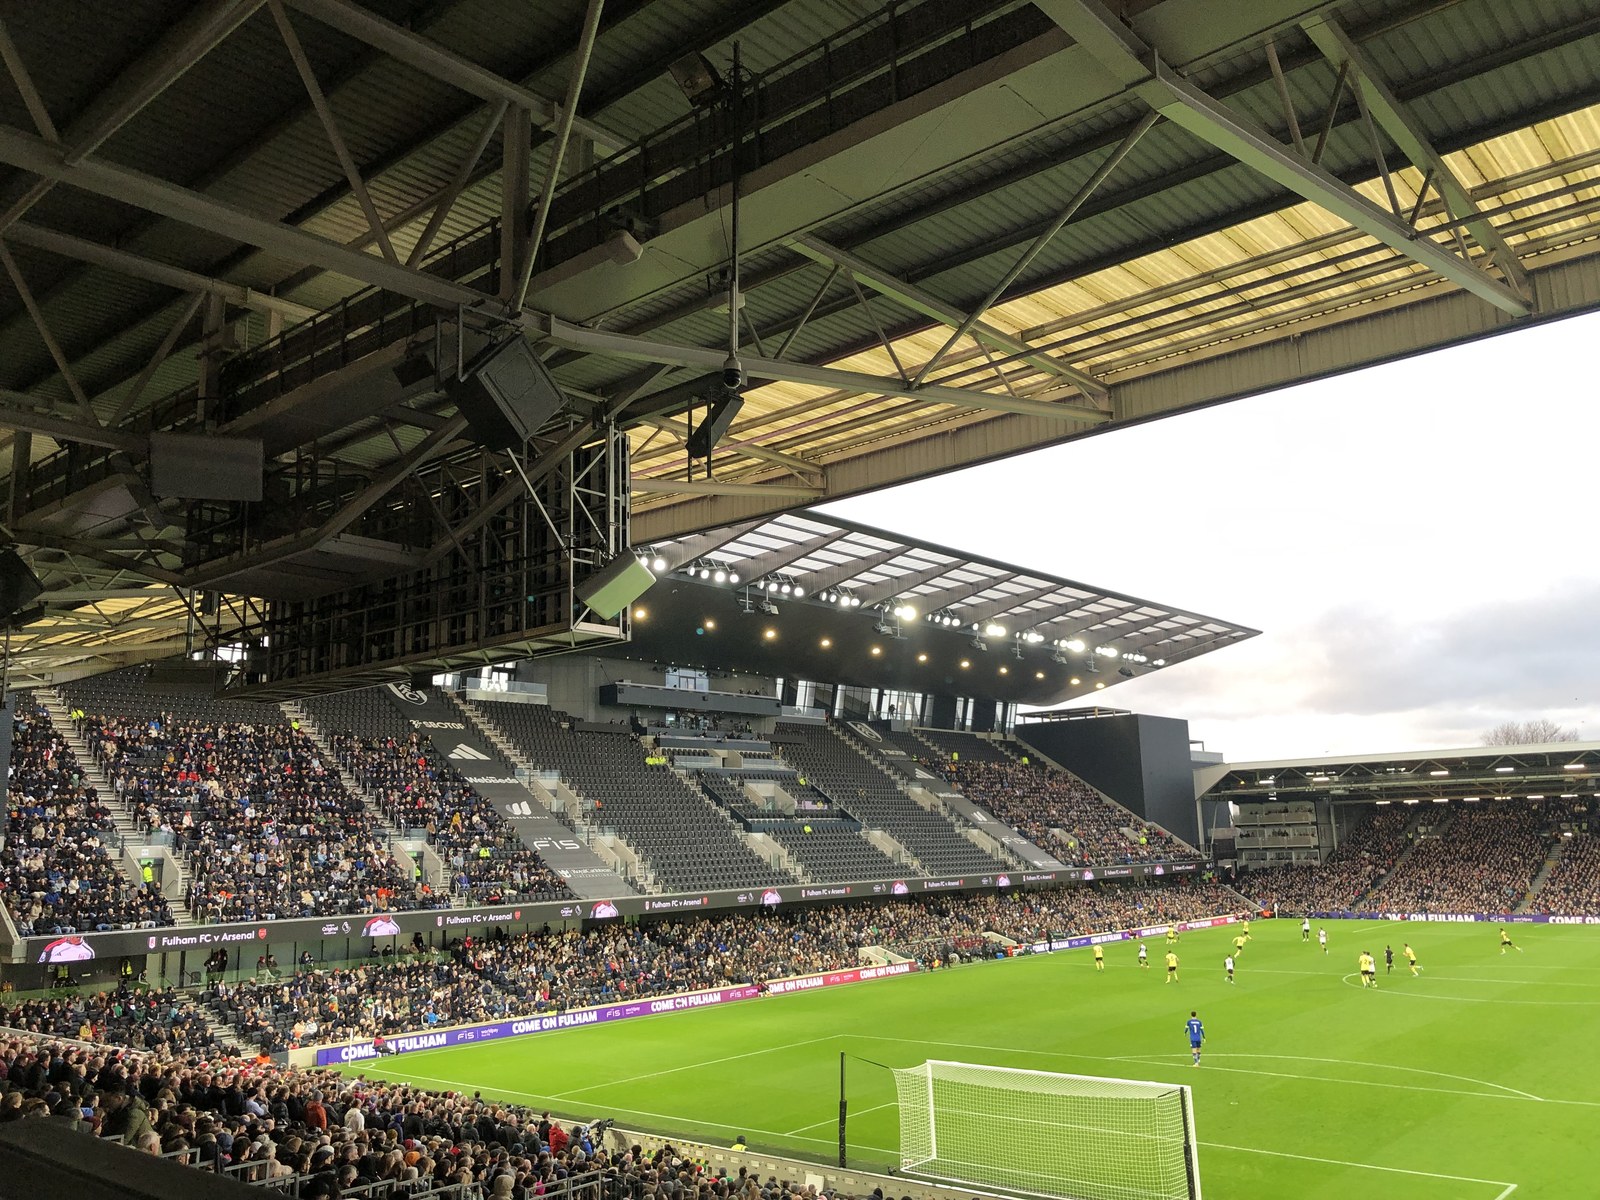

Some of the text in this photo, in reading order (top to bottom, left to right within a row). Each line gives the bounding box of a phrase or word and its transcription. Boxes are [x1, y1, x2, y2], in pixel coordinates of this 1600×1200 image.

[652, 901, 671, 909] Fulham
[683, 898, 702, 906] Arsenal
[446, 915, 471, 925] Fulham
[472, 914, 482, 922] FC
[488, 912, 513, 922] Arsenal
[1428, 913, 1475, 922] FULHAM
[1548, 916, 1583, 924] COME
[162, 936, 197, 946] Fulham
[199, 934, 212, 943] FC
[221, 930, 255, 941] Arsenal
[860, 968, 877, 979] COME
[877, 967, 886, 976] ON
[886, 964, 910, 975] FULHAM
[769, 981, 785, 993] OME
[785, 980, 796, 991] ON
[796, 977, 824, 990] FULHAM
[651, 1000, 675, 1012] COME
[688, 992, 721, 1007] FULHAM
[512, 1011, 598, 1034] COME ON FULHAM
[1193, 1025, 1197, 1034] 1
[341, 1044, 376, 1060] COME
[398, 1033, 447, 1052] FULHAM
